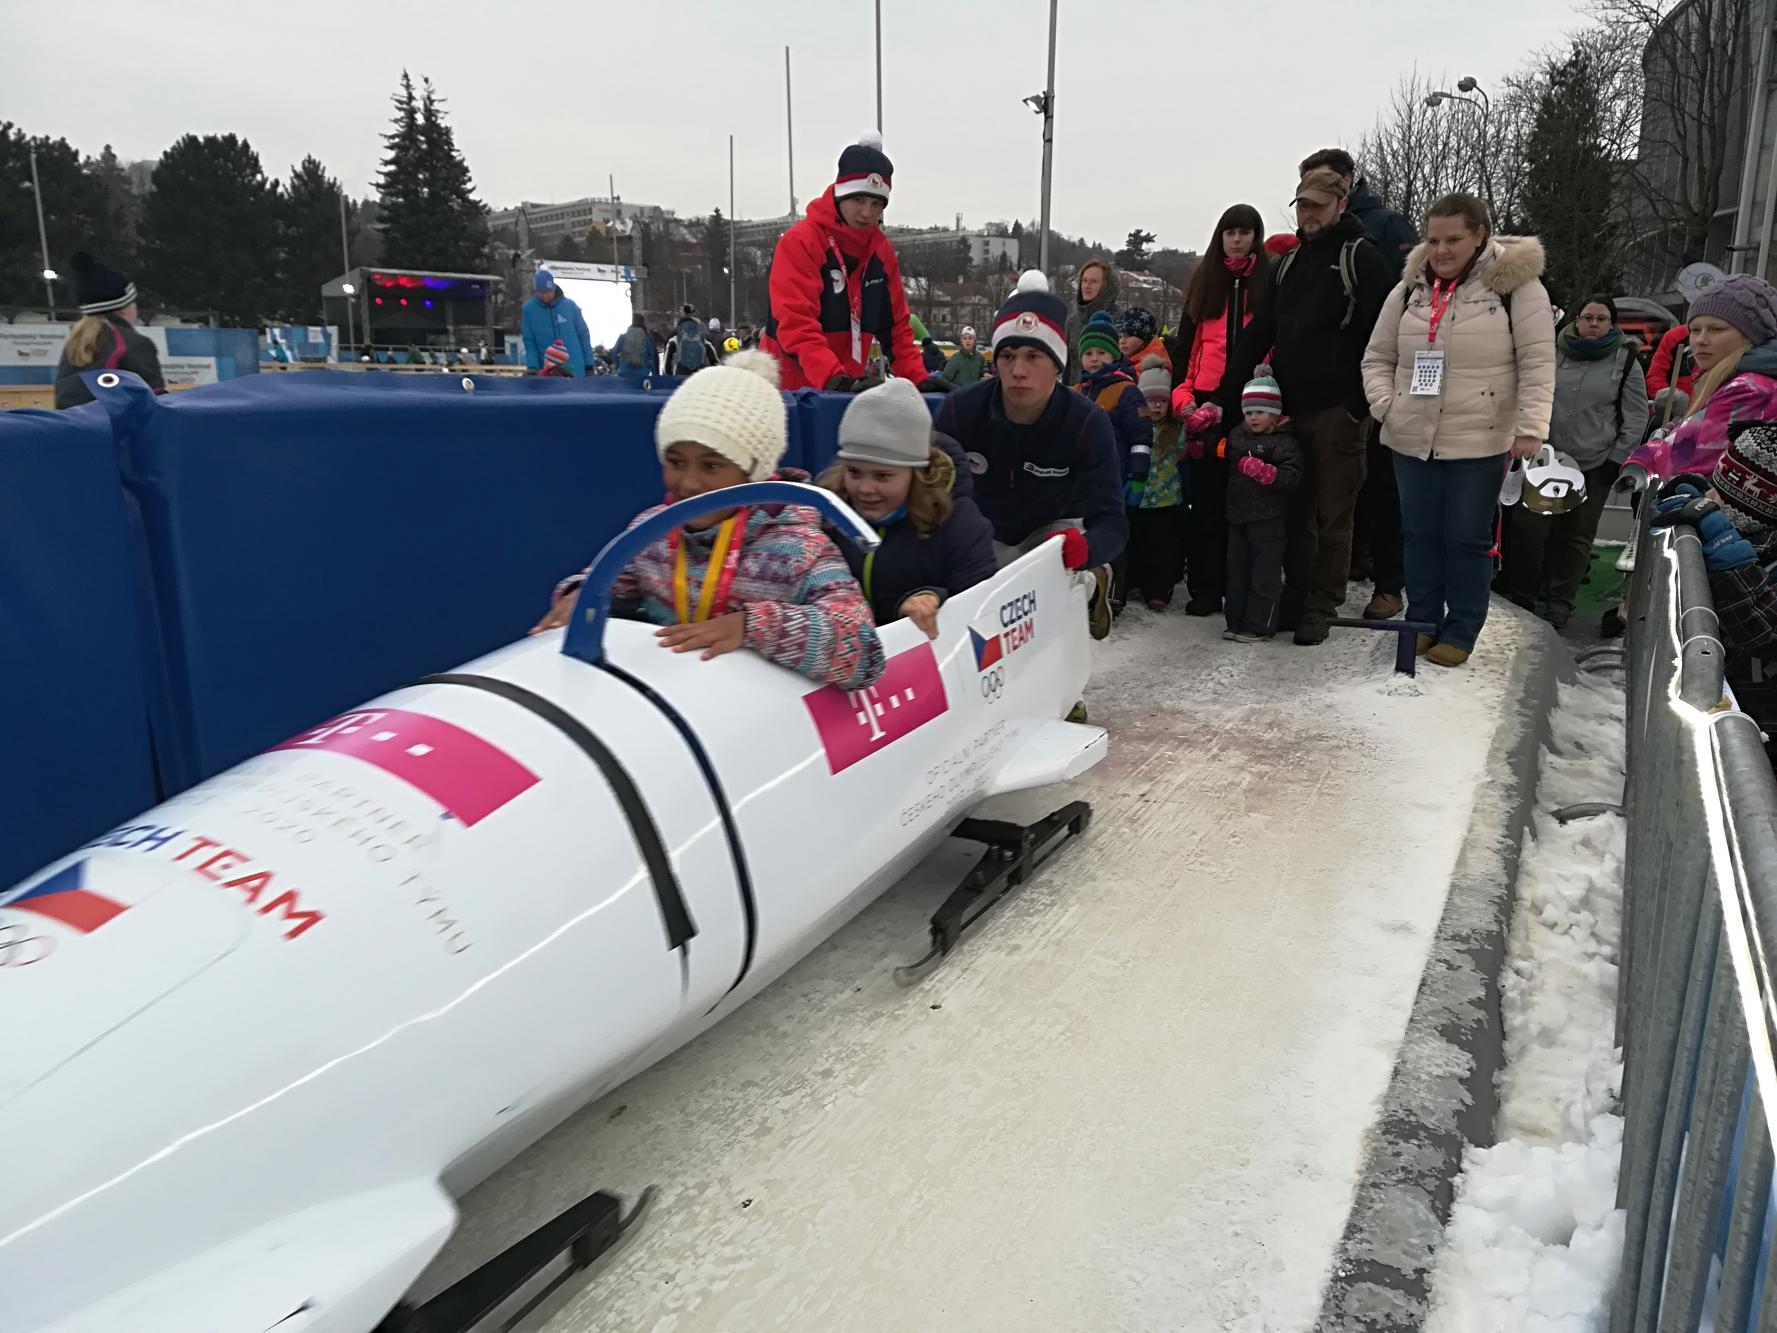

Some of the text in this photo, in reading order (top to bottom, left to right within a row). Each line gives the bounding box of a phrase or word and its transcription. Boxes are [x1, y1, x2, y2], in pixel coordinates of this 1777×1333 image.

[1000, 590, 1037, 628] CZECH
[1003, 617, 1035, 655] TEAM
[169, 834, 326, 942] TEAM
